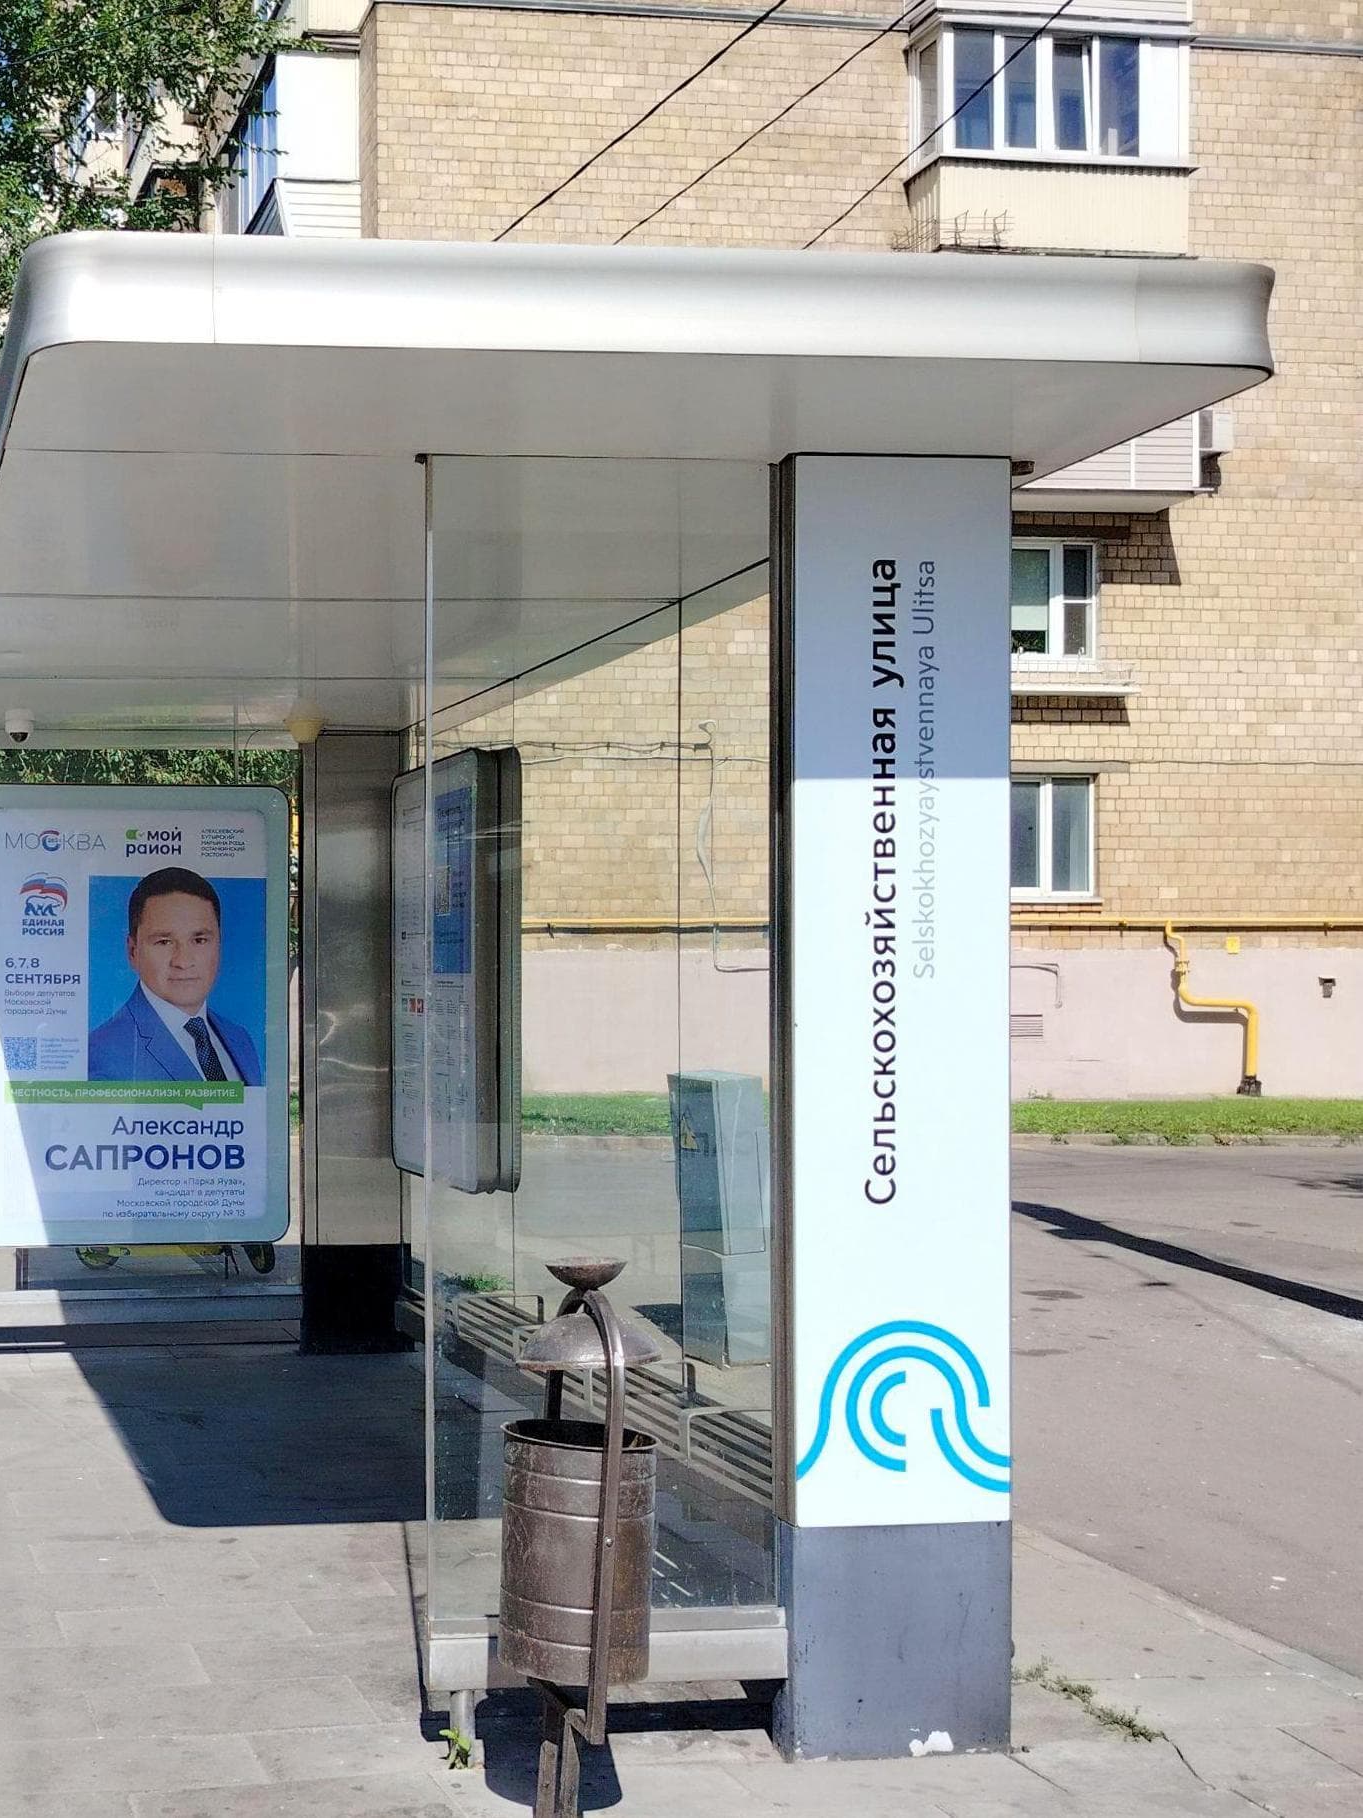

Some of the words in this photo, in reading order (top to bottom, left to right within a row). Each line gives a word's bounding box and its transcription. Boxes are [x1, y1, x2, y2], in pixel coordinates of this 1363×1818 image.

[911, 560, 936, 636] Ulitsa
[871, 558, 905, 689] улица
[911, 645, 941, 980] Selskokhozyaystvennaya
[147, 826, 182, 841] мой
[5, 830, 107, 851] МОСКВА
[22, 919, 65, 927] ЕДИНАЯ
[22, 928, 65, 936] РОССИЯ
[864, 707, 897, 1205] Сельскохозяйственная
[5, 973, 82, 985] СЕНТЯБРЯ
[75, 1088, 184, 1098] ПРОФЕССИОНАЛИЗМ.
[185, 1088, 238, 1098] РАЗВИТИЕ.
[111, 1115, 245, 1139] Александр
[45, 1144, 246, 1171] САПРОНОВ
[137, 1177, 181, 1187] Директор
[154, 1189, 195, 1197] кандидат
[204, 1189, 245, 1198] депутаты
[116, 1199, 171, 1207] Московской
[173, 1199, 219, 1208] городской
[221, 1200, 245, 1208] Думы
[116, 1209, 190, 1219] избирательному
[191, 1211, 220, 1219] округу
